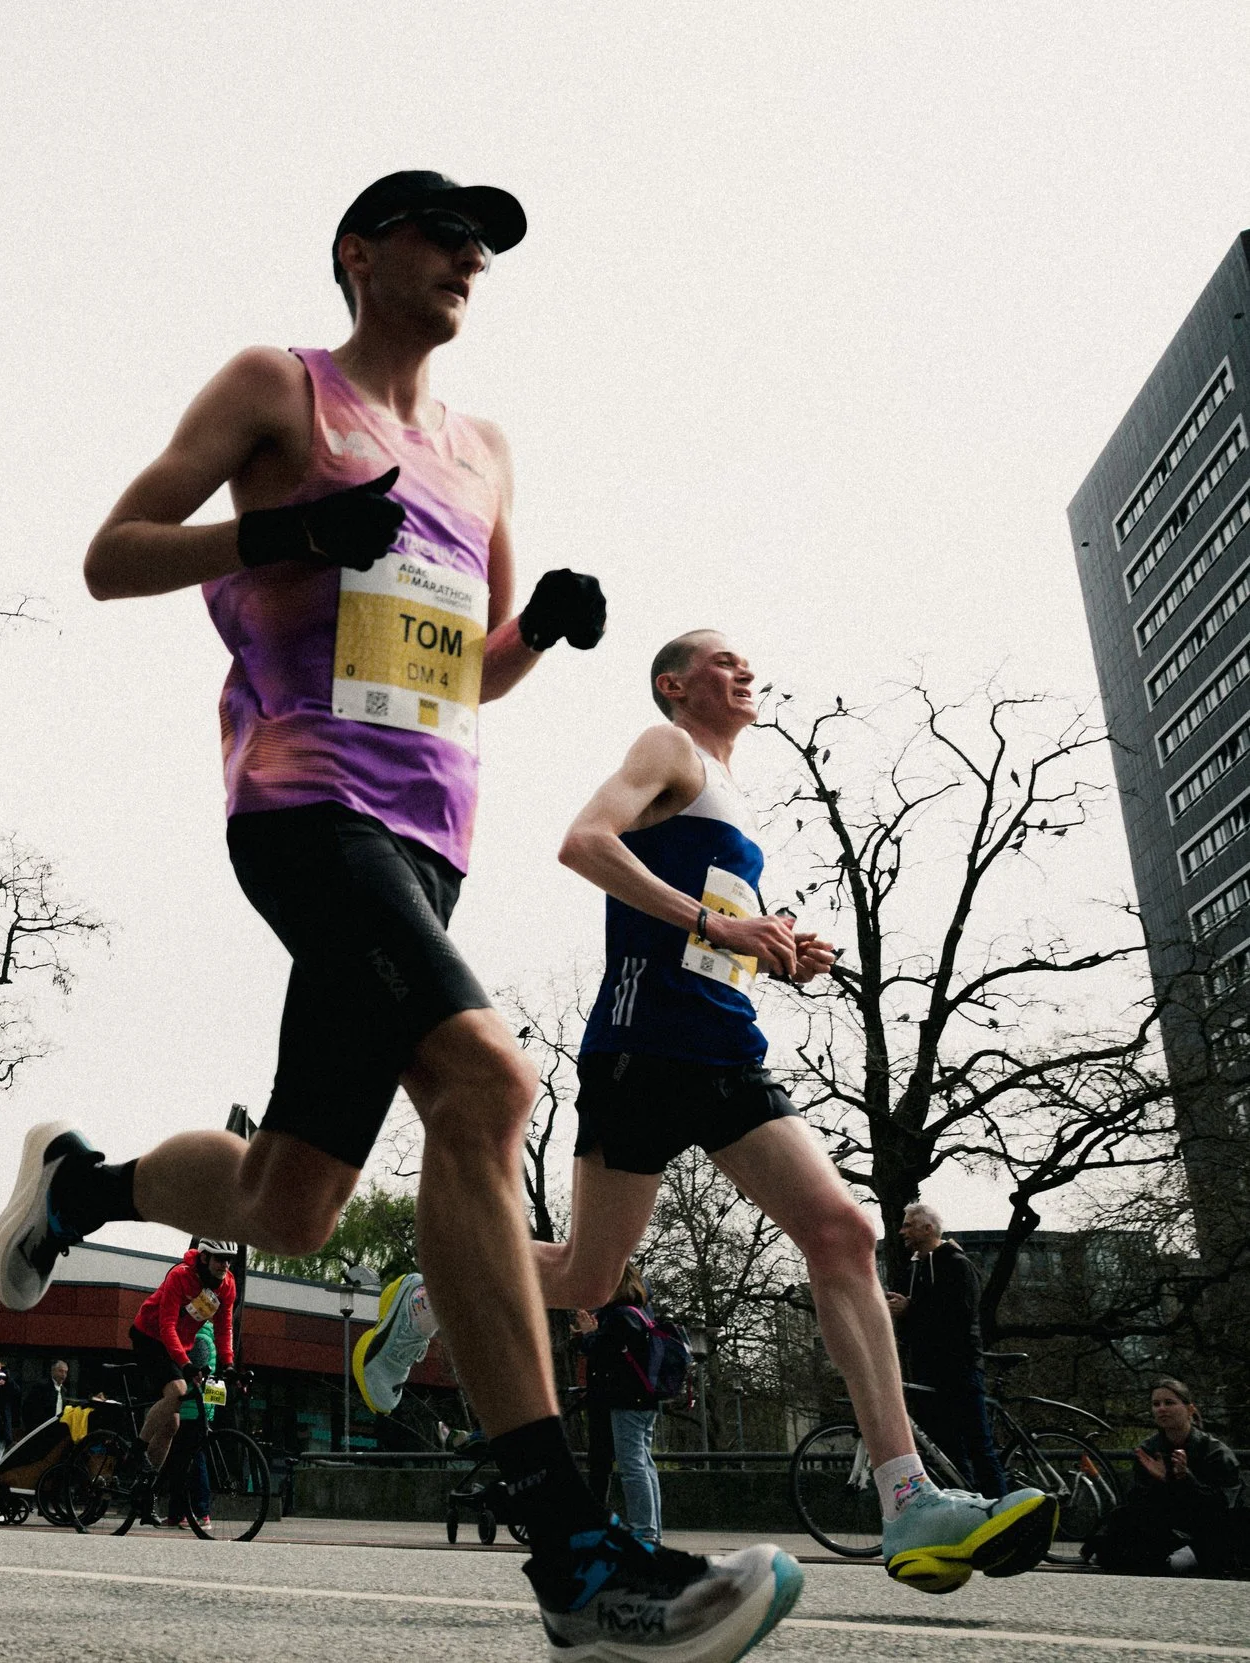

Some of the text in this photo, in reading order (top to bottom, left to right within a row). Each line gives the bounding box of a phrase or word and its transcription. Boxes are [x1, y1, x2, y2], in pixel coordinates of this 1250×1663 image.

[411, 576, 472, 602] MARATHON
[399, 613, 463, 657] TOM
[439, 672, 449, 687] 4
